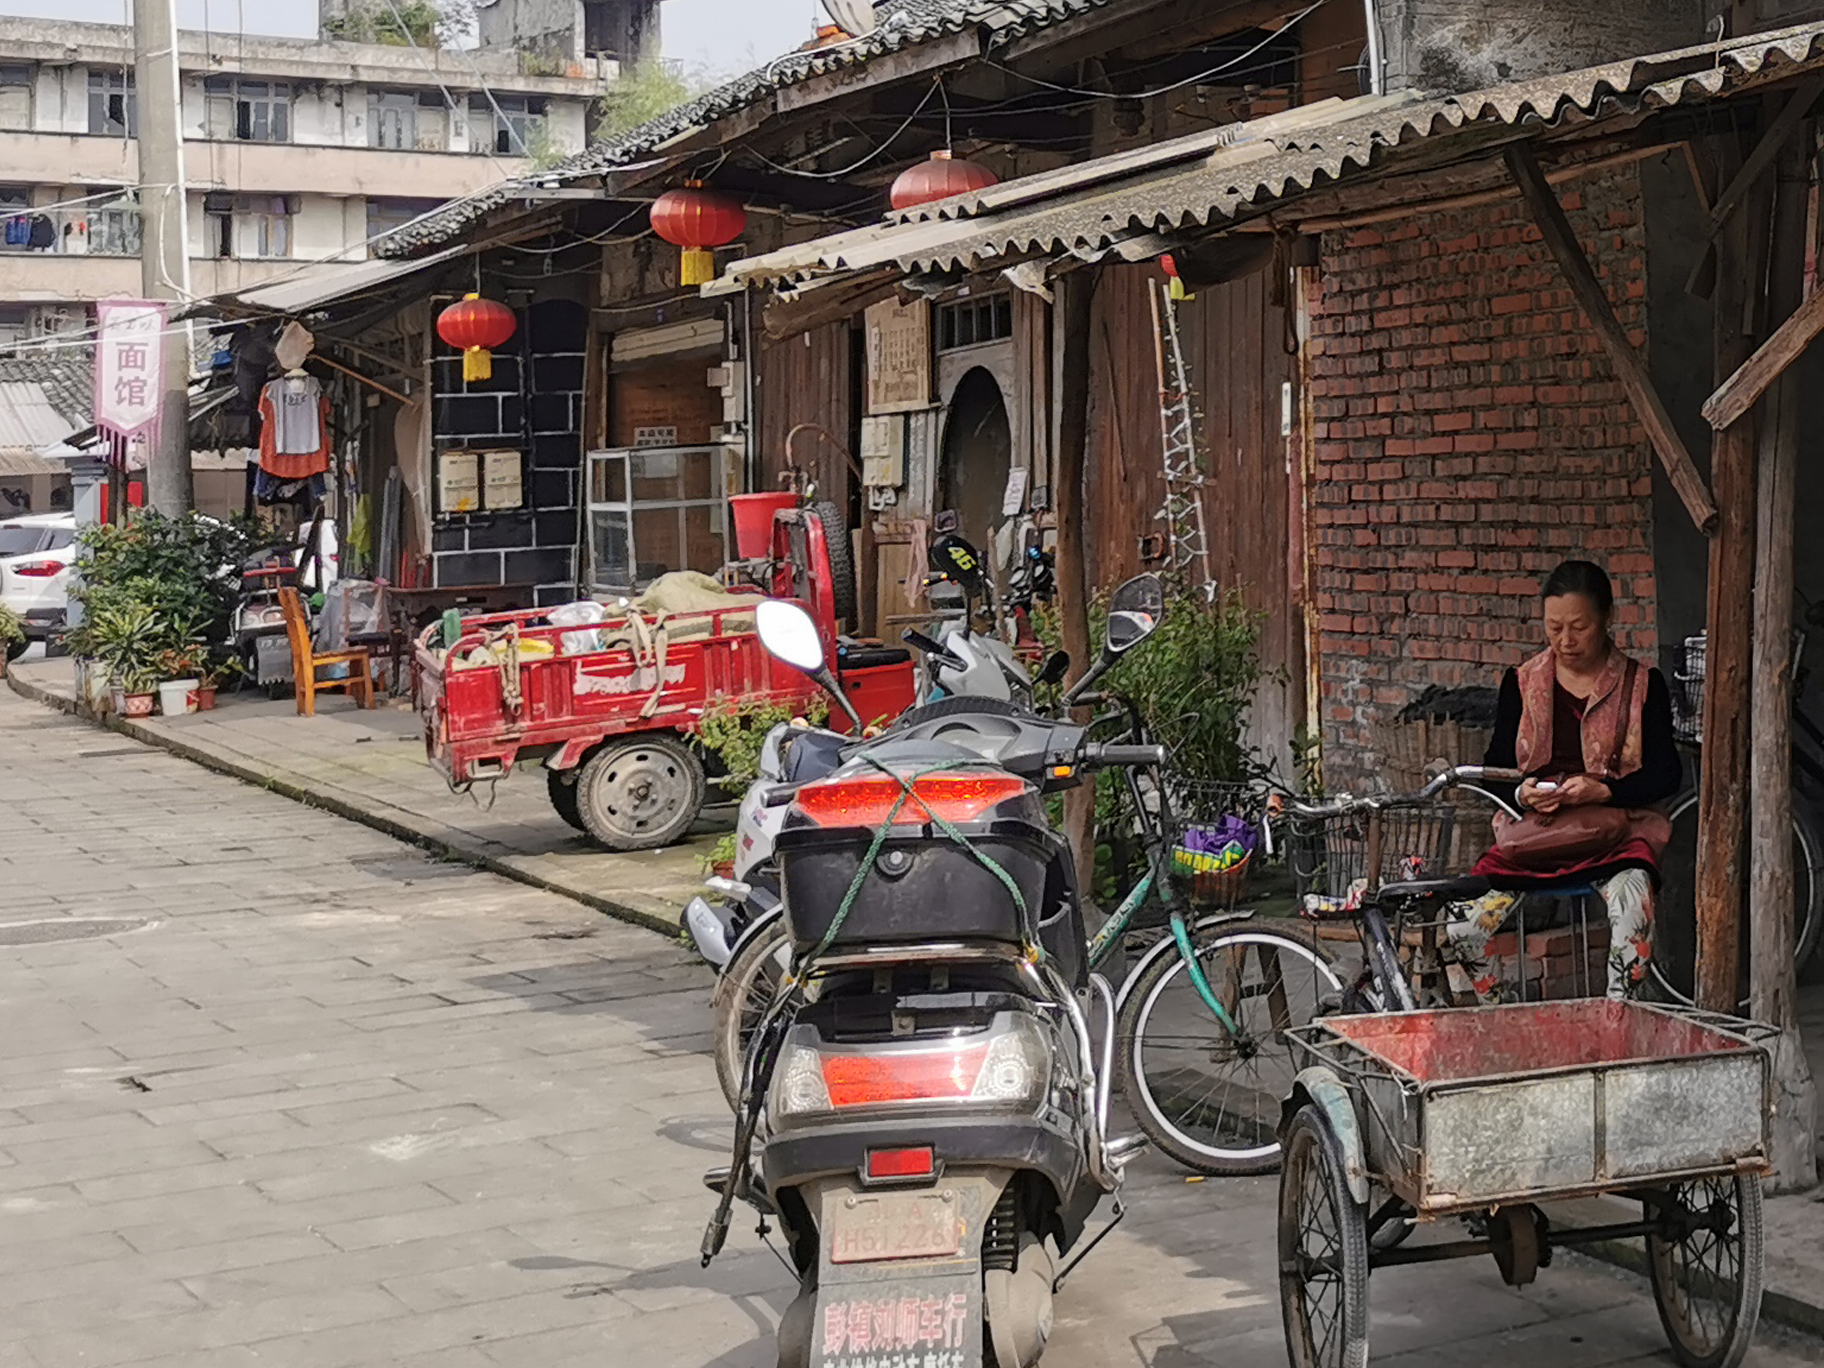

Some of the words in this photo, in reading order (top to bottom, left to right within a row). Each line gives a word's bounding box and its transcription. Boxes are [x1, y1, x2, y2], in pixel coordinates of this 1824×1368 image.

[115, 341, 148, 407] 面馆
[947, 546, 977, 571] 46
[823, 1292, 967, 1356] 彭镇刘师车行
